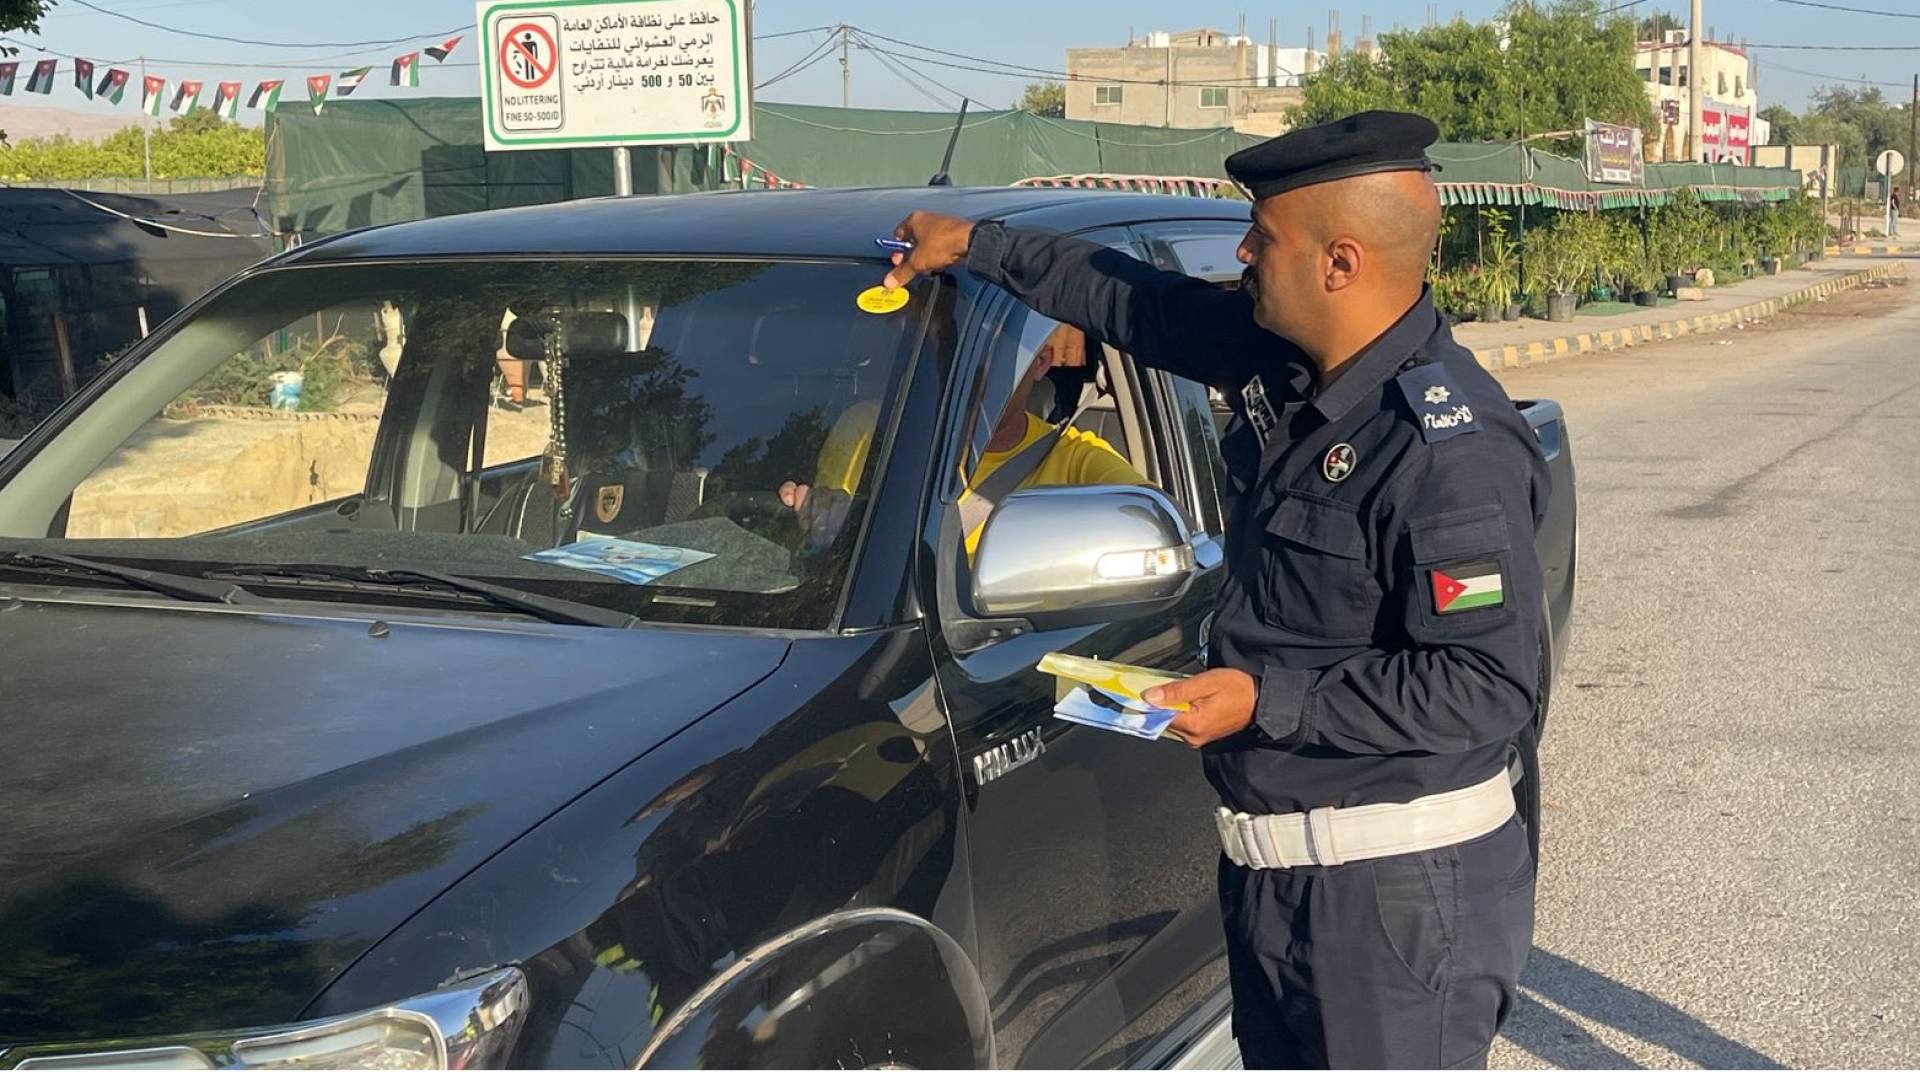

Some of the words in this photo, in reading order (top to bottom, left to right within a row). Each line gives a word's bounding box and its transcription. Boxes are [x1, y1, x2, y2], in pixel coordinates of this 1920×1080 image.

[630, 15, 662, 28] نظافة
[665, 14, 686, 30] على
[689, 11, 721, 25] حافظ
[563, 19, 592, 31] العامة
[594, 16, 628, 34] الأماكن
[570, 38, 621, 53] للنفايات
[625, 36, 676, 54] العشوائي
[679, 33, 713, 52] الرمي
[572, 60, 605, 76] تتراوح
[607, 59, 634, 72] مالية
[636, 57, 668, 70] لغرامة
[671, 55, 714, 69] يعرضك
[607, 77, 634, 90] دينار
[641, 75, 662, 88] 500
[667, 76, 672, 88] و
[679, 74, 693, 87] 50
[695, 74, 715, 87] بين
[504, 96, 518, 107] NO
[518, 95, 559, 107] LITTERING
[505, 112, 523, 123] FINE
[974, 726, 1046, 786] HILUX
